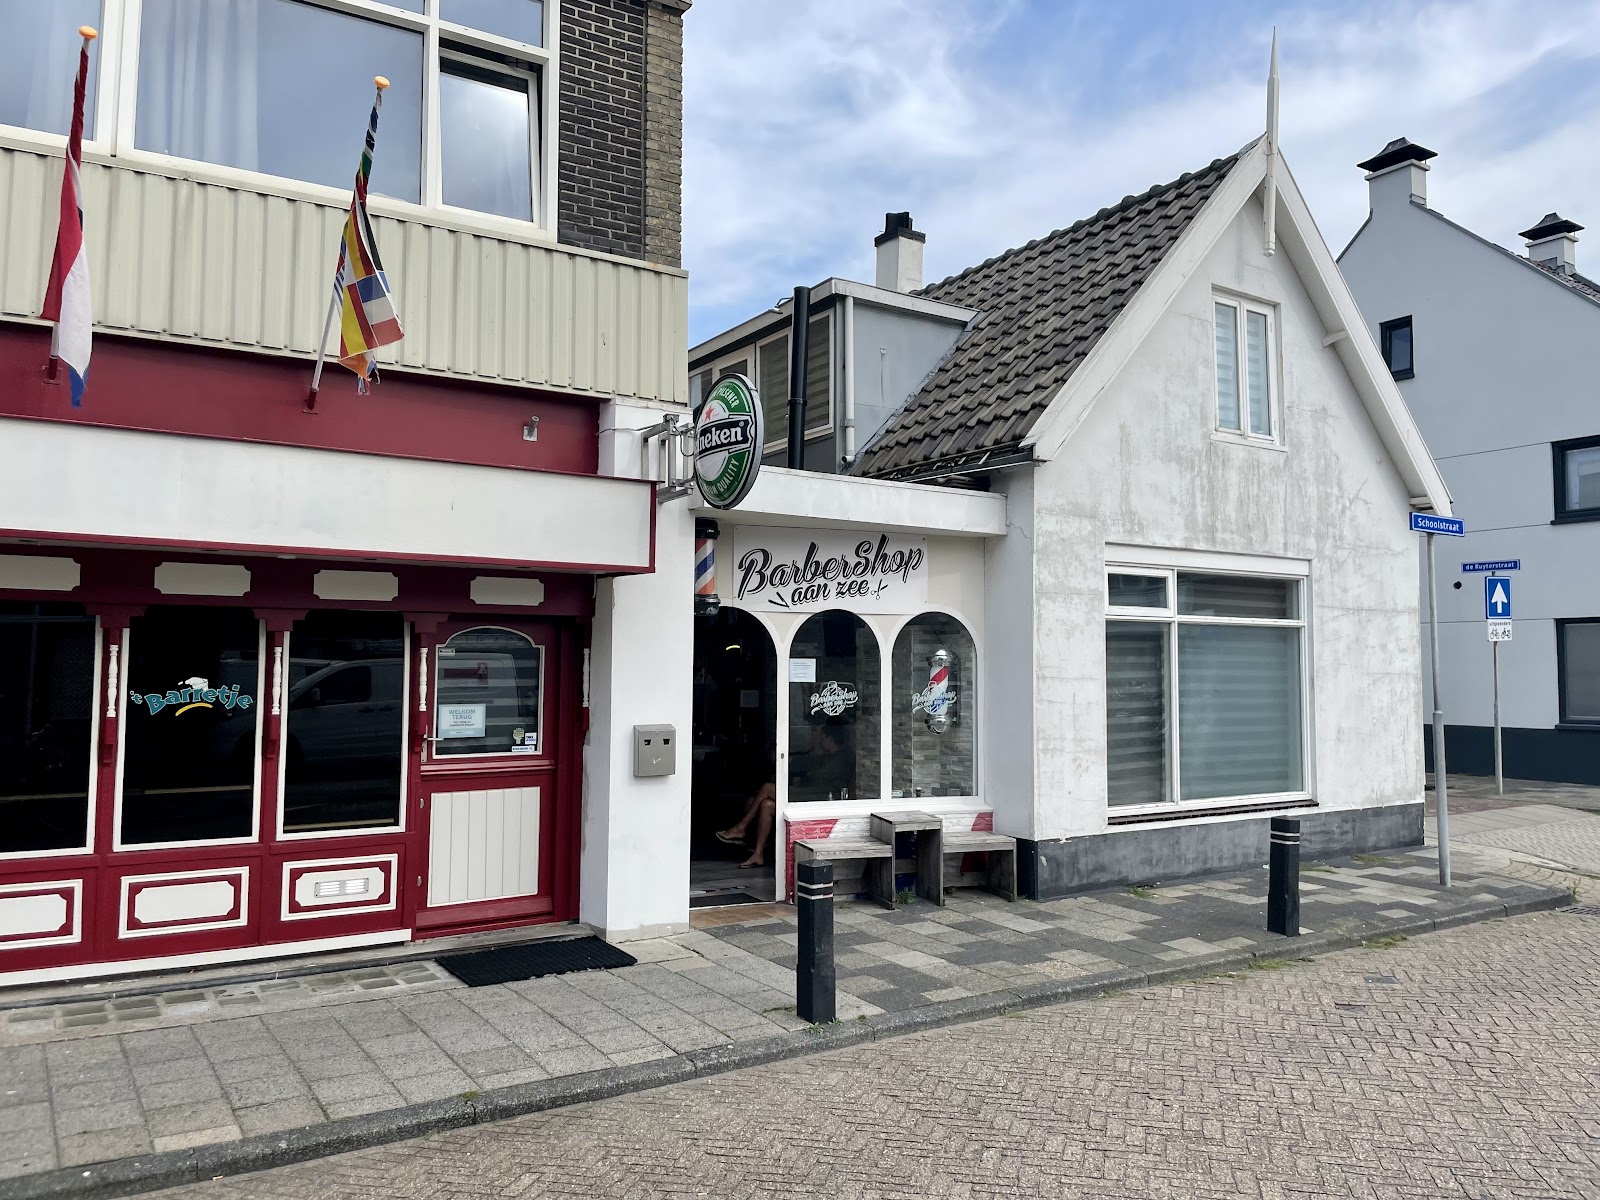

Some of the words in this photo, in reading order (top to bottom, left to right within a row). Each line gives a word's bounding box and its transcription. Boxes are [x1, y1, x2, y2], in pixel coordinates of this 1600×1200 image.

[698, 427, 743, 451] neken
[717, 458, 739, 492] QUALITY
[1417, 517, 1460, 531] Schoolstraat
[738, 533, 924, 600] BarberShop
[1475, 562, 1515, 570] Ruyterstraat
[791, 583, 830, 605] aan
[836, 579, 869, 598] zee
[144, 684, 253, 715] Barretje
